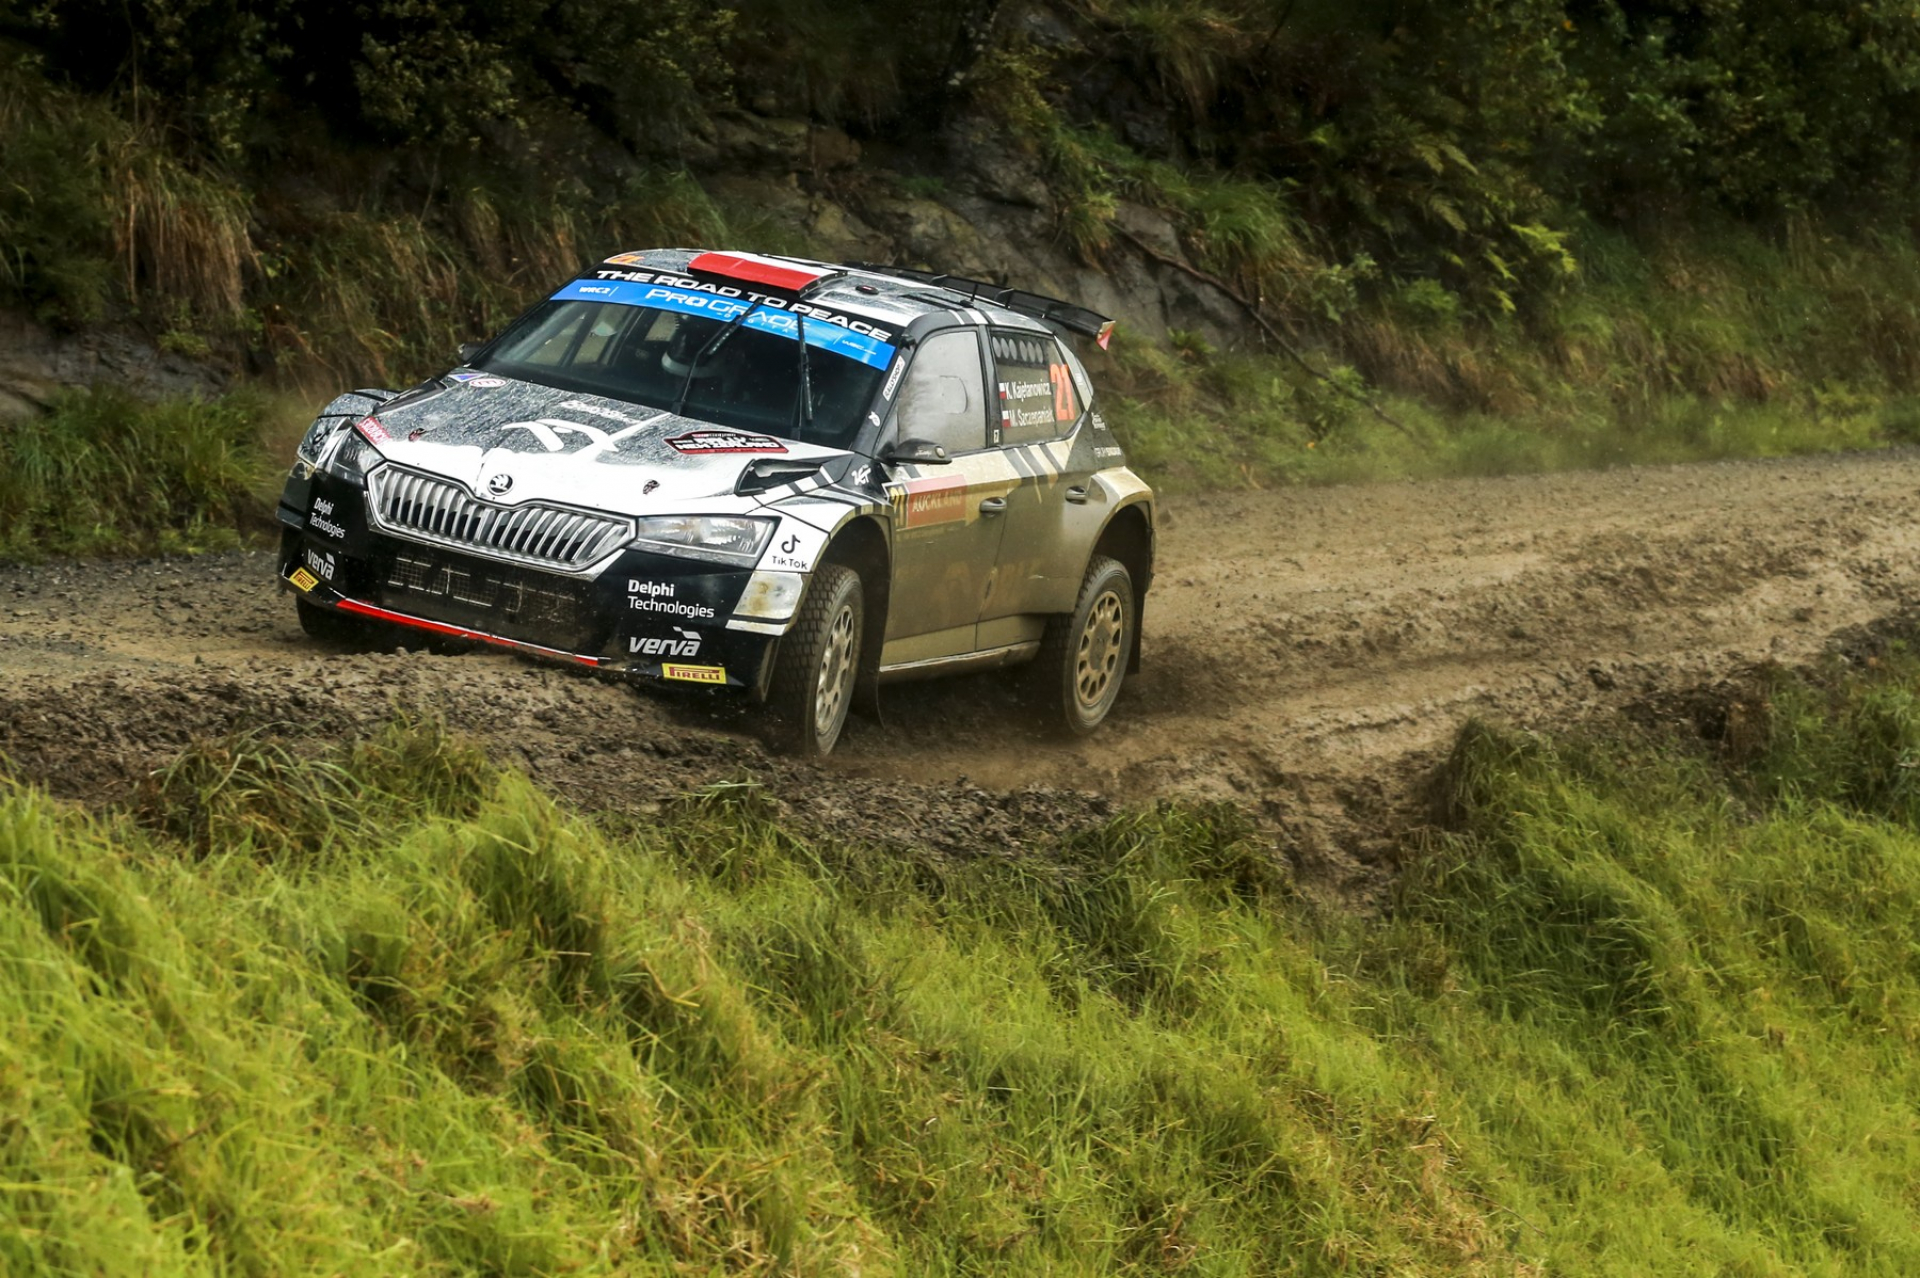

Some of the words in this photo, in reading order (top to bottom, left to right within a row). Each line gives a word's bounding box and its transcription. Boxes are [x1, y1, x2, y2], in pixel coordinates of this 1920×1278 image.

[578, 286, 612, 295] WRC2
[597, 270, 655, 283] THE
[653, 275, 741, 298] ROAD
[747, 292, 788, 309] TO
[789, 303, 892, 343] PEACE
[1049, 363, 1076, 420] 21
[313, 497, 334, 516] Delphi
[310, 512, 346, 539] Technologies
[628, 579, 675, 598] Delphi
[628, 596, 715, 619] Technologies
[629, 636, 701, 657] verva
[668, 666, 720, 681] PIRELLI
